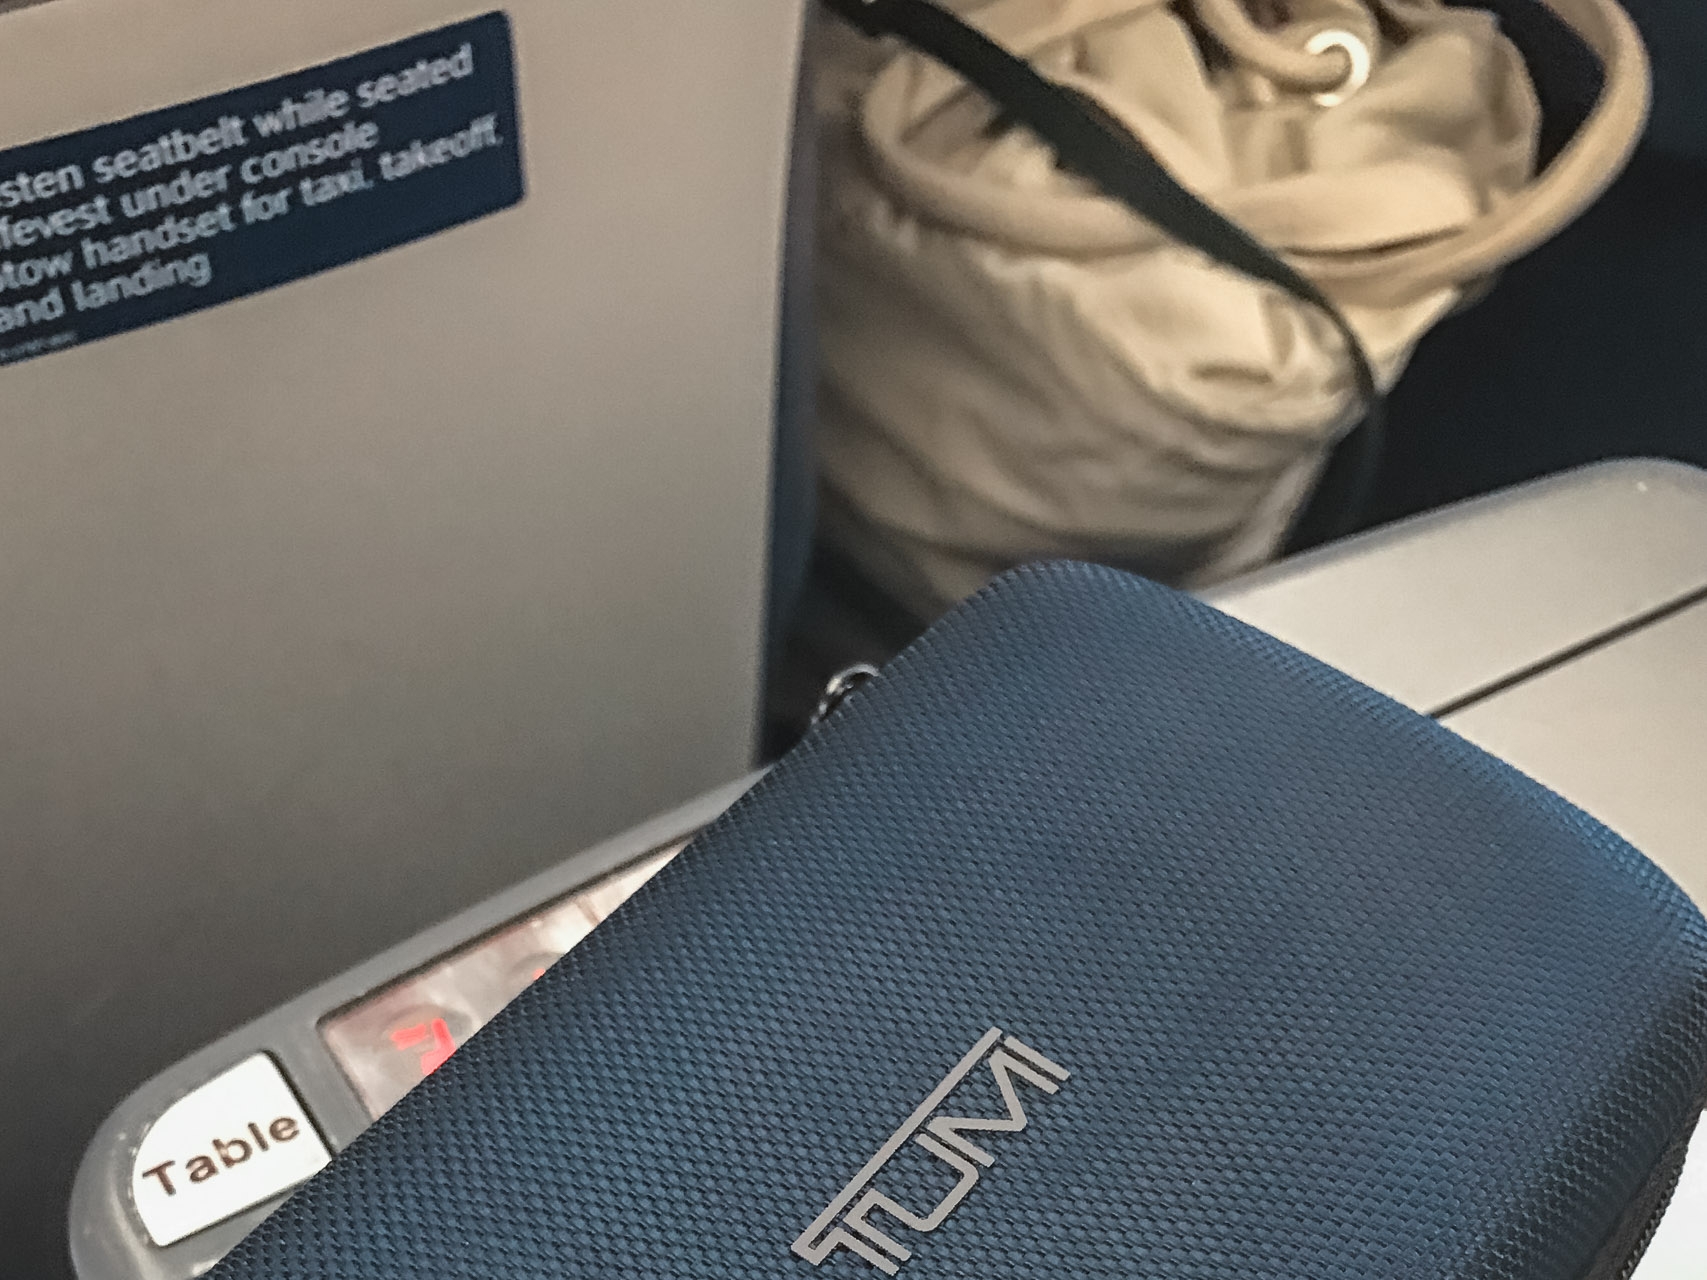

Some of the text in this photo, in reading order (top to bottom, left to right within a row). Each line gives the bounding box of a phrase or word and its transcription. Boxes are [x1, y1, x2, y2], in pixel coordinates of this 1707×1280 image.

[92, 115, 248, 183] seatbelt
[252, 88, 349, 137] while
[357, 42, 473, 108] seated
[119, 164, 232, 218] under
[241, 121, 379, 183] console
[81, 203, 237, 270] handset
[241, 186, 292, 225] for
[0, 252, 213, 333] and landing
[142, 1114, 301, 1196] Table
[790, 1026, 1071, 1276] TUMI
